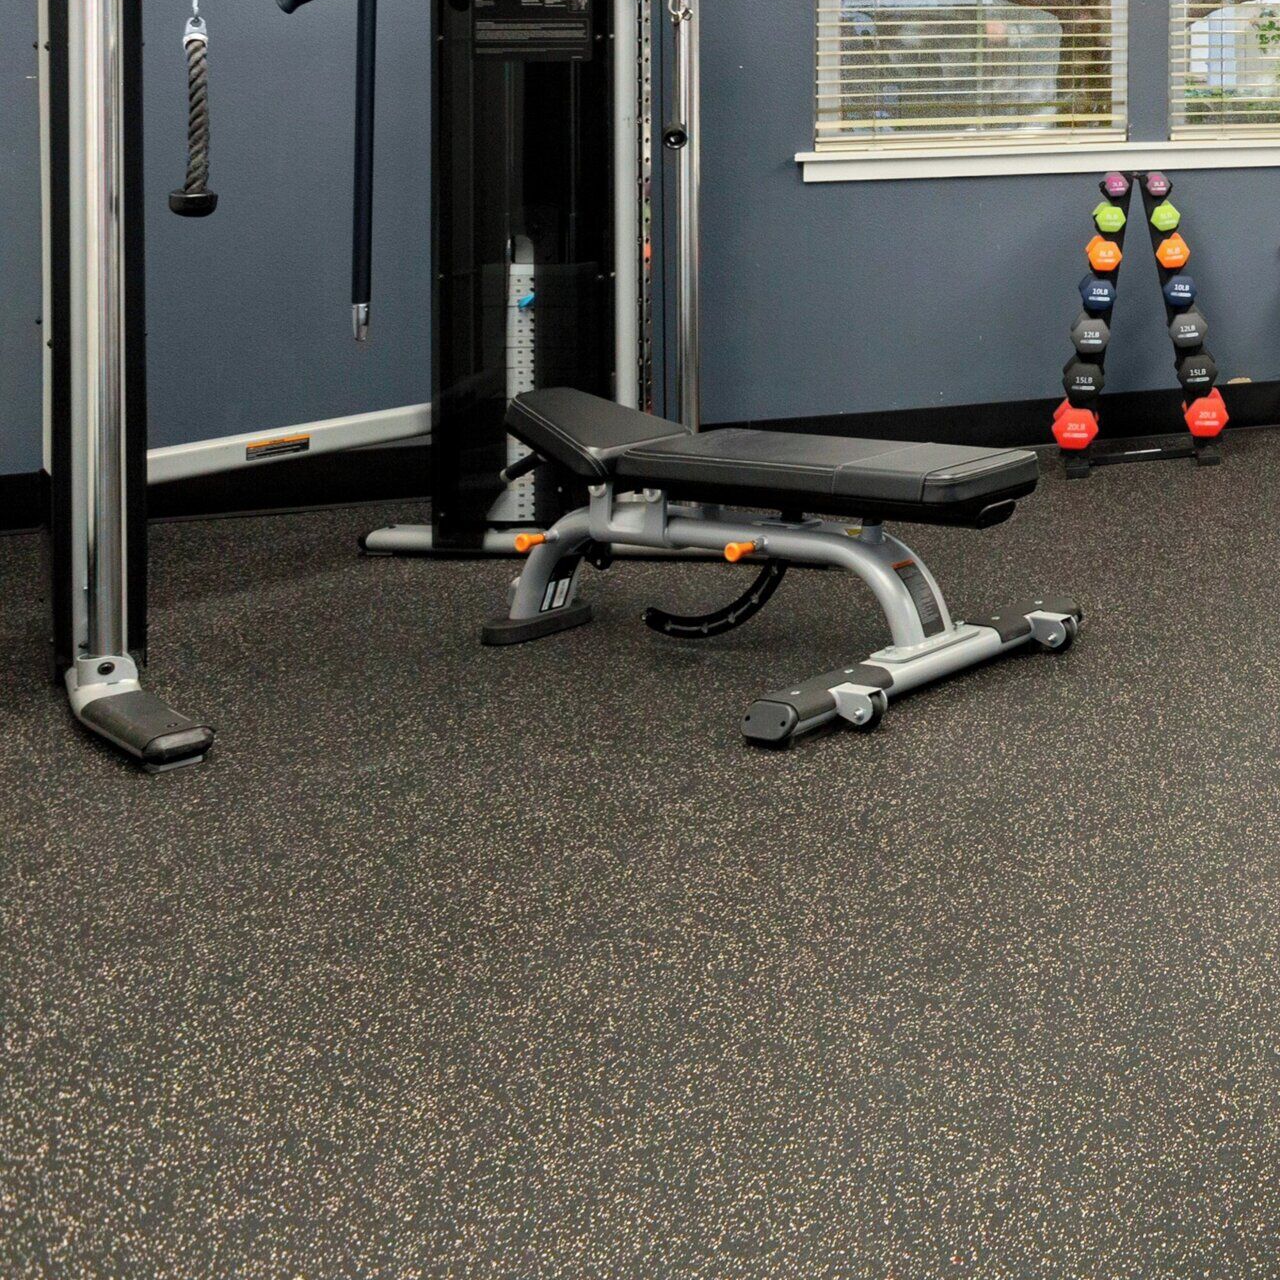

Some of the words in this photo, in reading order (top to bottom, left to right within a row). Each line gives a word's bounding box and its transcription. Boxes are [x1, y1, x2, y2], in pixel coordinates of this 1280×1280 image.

[1174, 283, 1190, 292] 10LB
[1092, 288, 1109, 296] 10LB
[1180, 325, 1196, 333] 12LB
[1189, 368, 1207, 376] 15LB
[1075, 376, 1093, 384] 15LB
[1198, 411, 1217, 419] 20LB
[1066, 423, 1086, 431] 20LB
